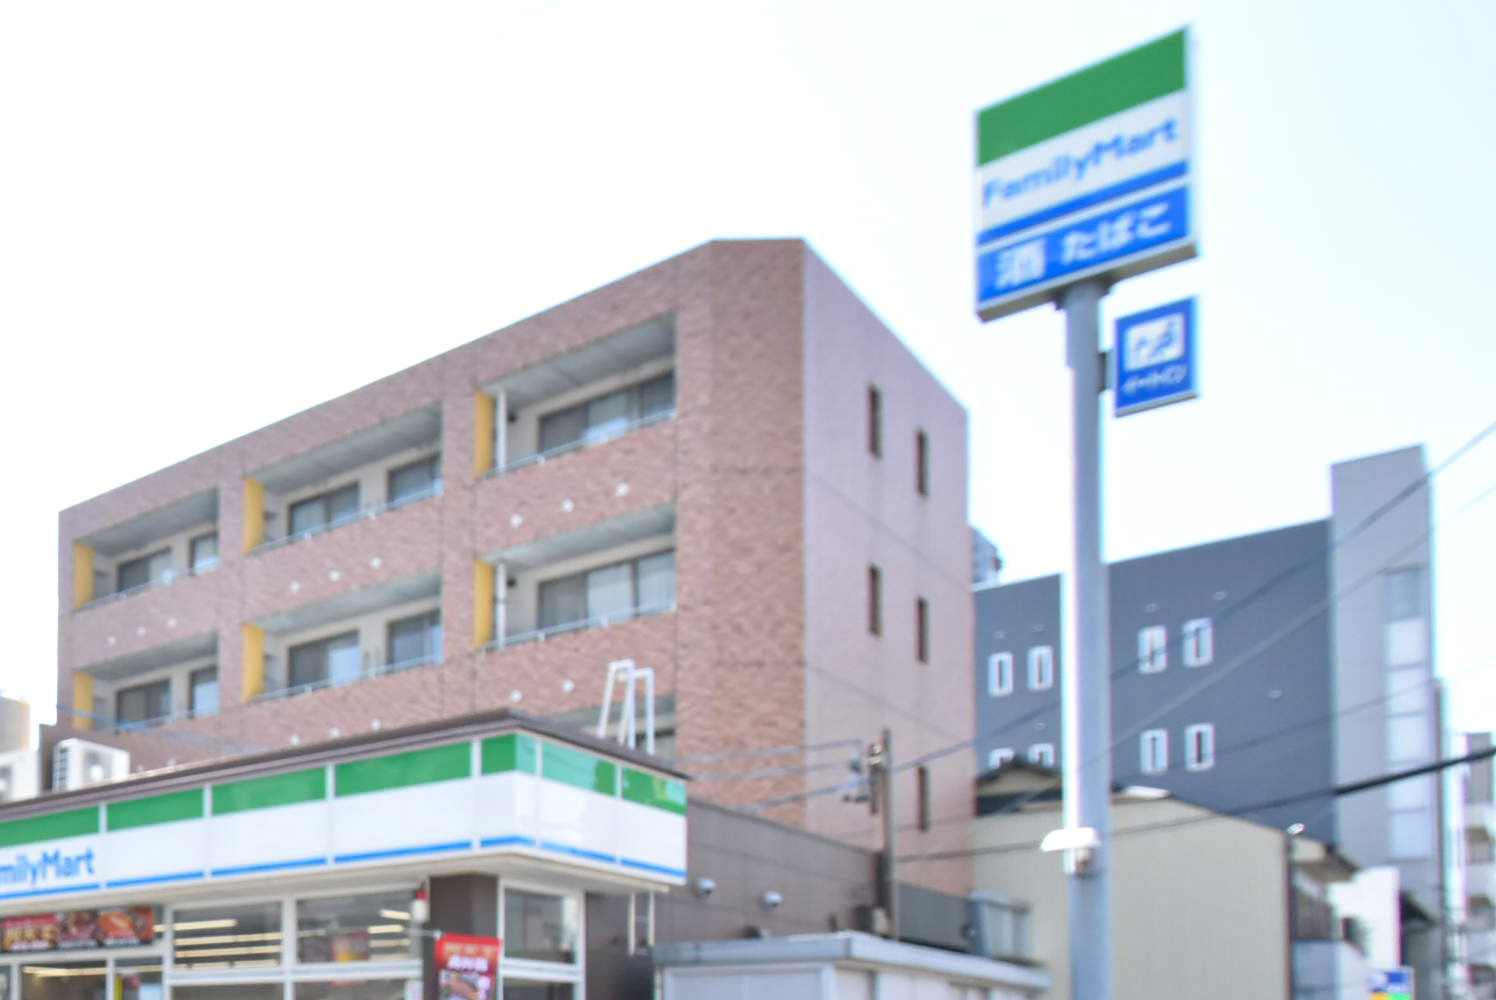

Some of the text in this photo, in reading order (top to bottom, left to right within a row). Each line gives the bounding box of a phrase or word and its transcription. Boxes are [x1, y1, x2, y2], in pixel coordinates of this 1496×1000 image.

[984, 117, 1178, 206] FamilyMart
[994, 203, 1172, 289] 酒 たばこ
